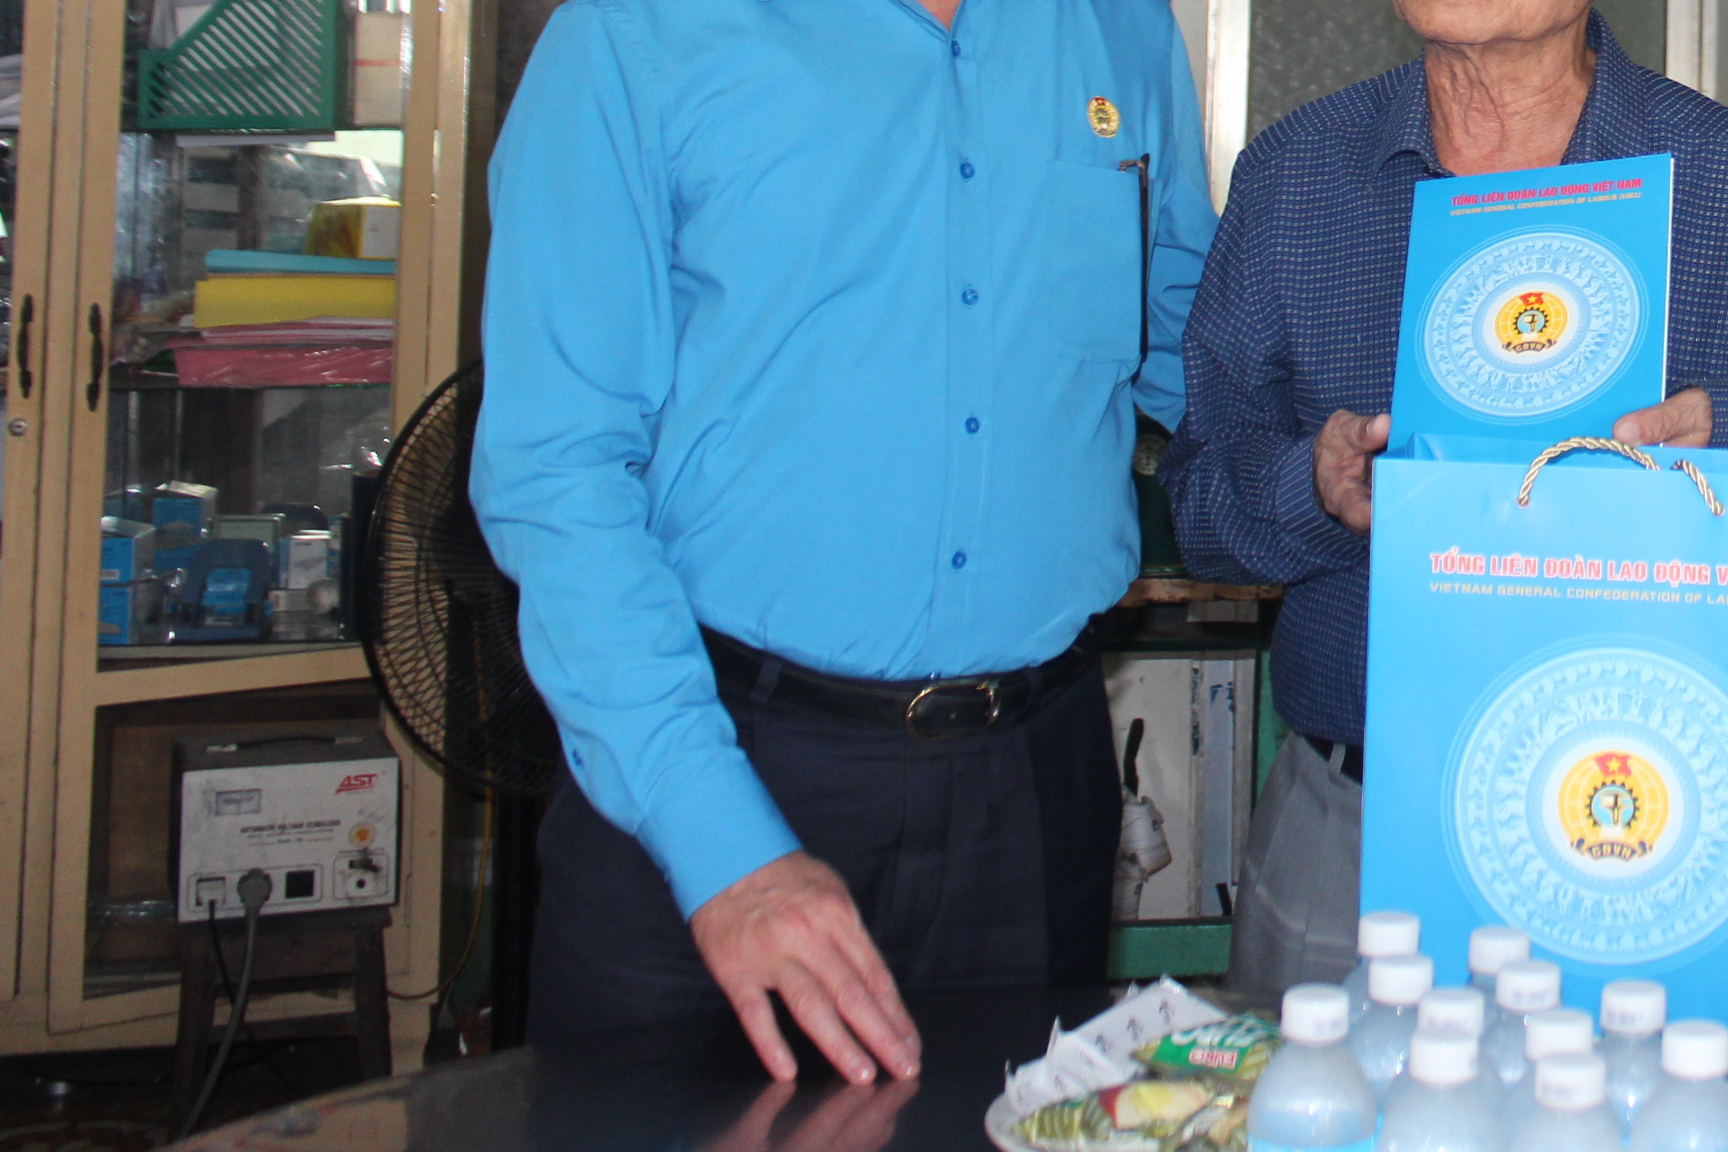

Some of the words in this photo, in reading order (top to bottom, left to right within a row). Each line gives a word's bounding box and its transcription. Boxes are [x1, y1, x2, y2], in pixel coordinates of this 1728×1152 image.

[1451, 193, 1479, 206] TỔNG
[1481, 190, 1505, 203] LIÊN
[1538, 186, 1558, 198] LAO
[1592, 180, 1615, 194] VIỆT
[1616, 178, 1643, 190] NAM
[1429, 545, 1485, 575] TỔNG
[1490, 553, 1539, 578] LIÊN
[1544, 554, 1603, 581] ĐOÀN
[1607, 559, 1648, 582] LAO
[1653, 559, 1711, 588] ĐỘNG
[1430, 582, 1494, 596] VIETNAM
[1497, 585, 1562, 598] GENERAL
[1566, 588, 1680, 603] CONFEDERATION
[1684, 593, 1703, 604] OF
